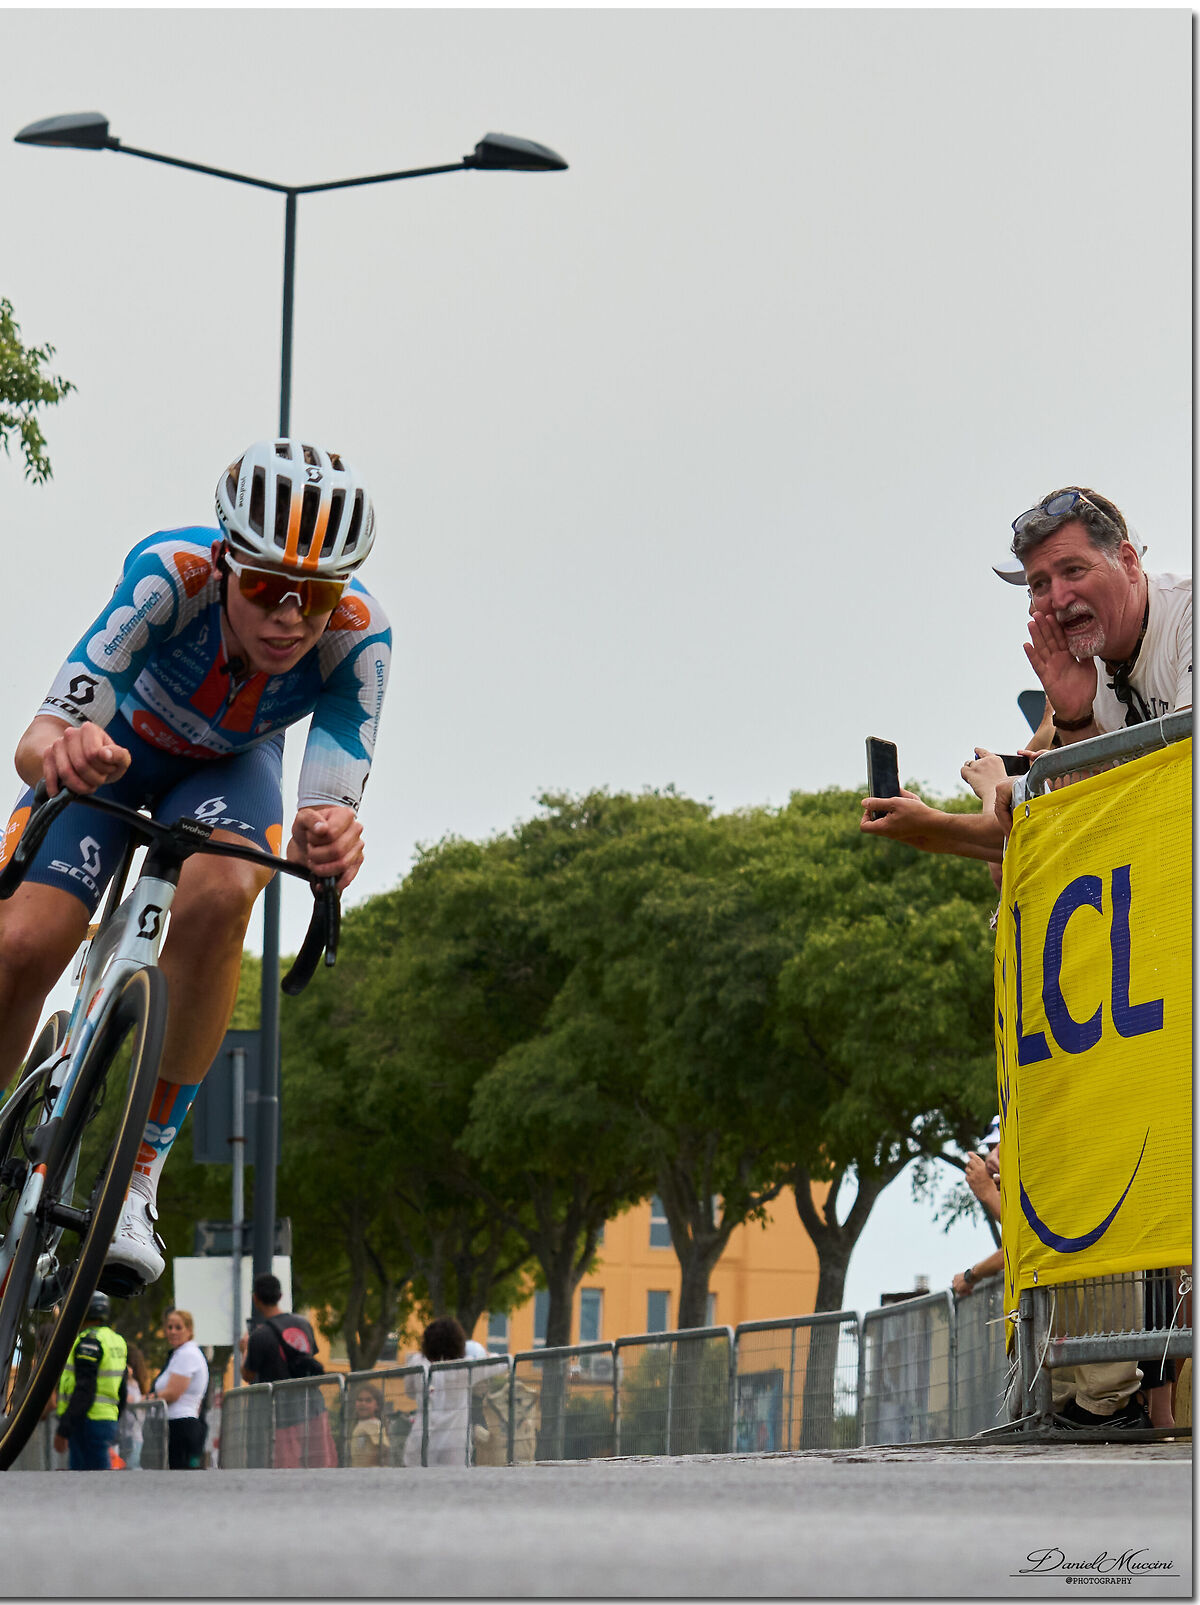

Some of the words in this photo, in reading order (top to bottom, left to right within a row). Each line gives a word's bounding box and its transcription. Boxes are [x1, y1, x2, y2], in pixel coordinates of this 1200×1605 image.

[104, 590, 163, 657] dsm-firmenich
[182, 823, 211, 839] wahoo
[1011, 863, 1165, 1068] LCL
